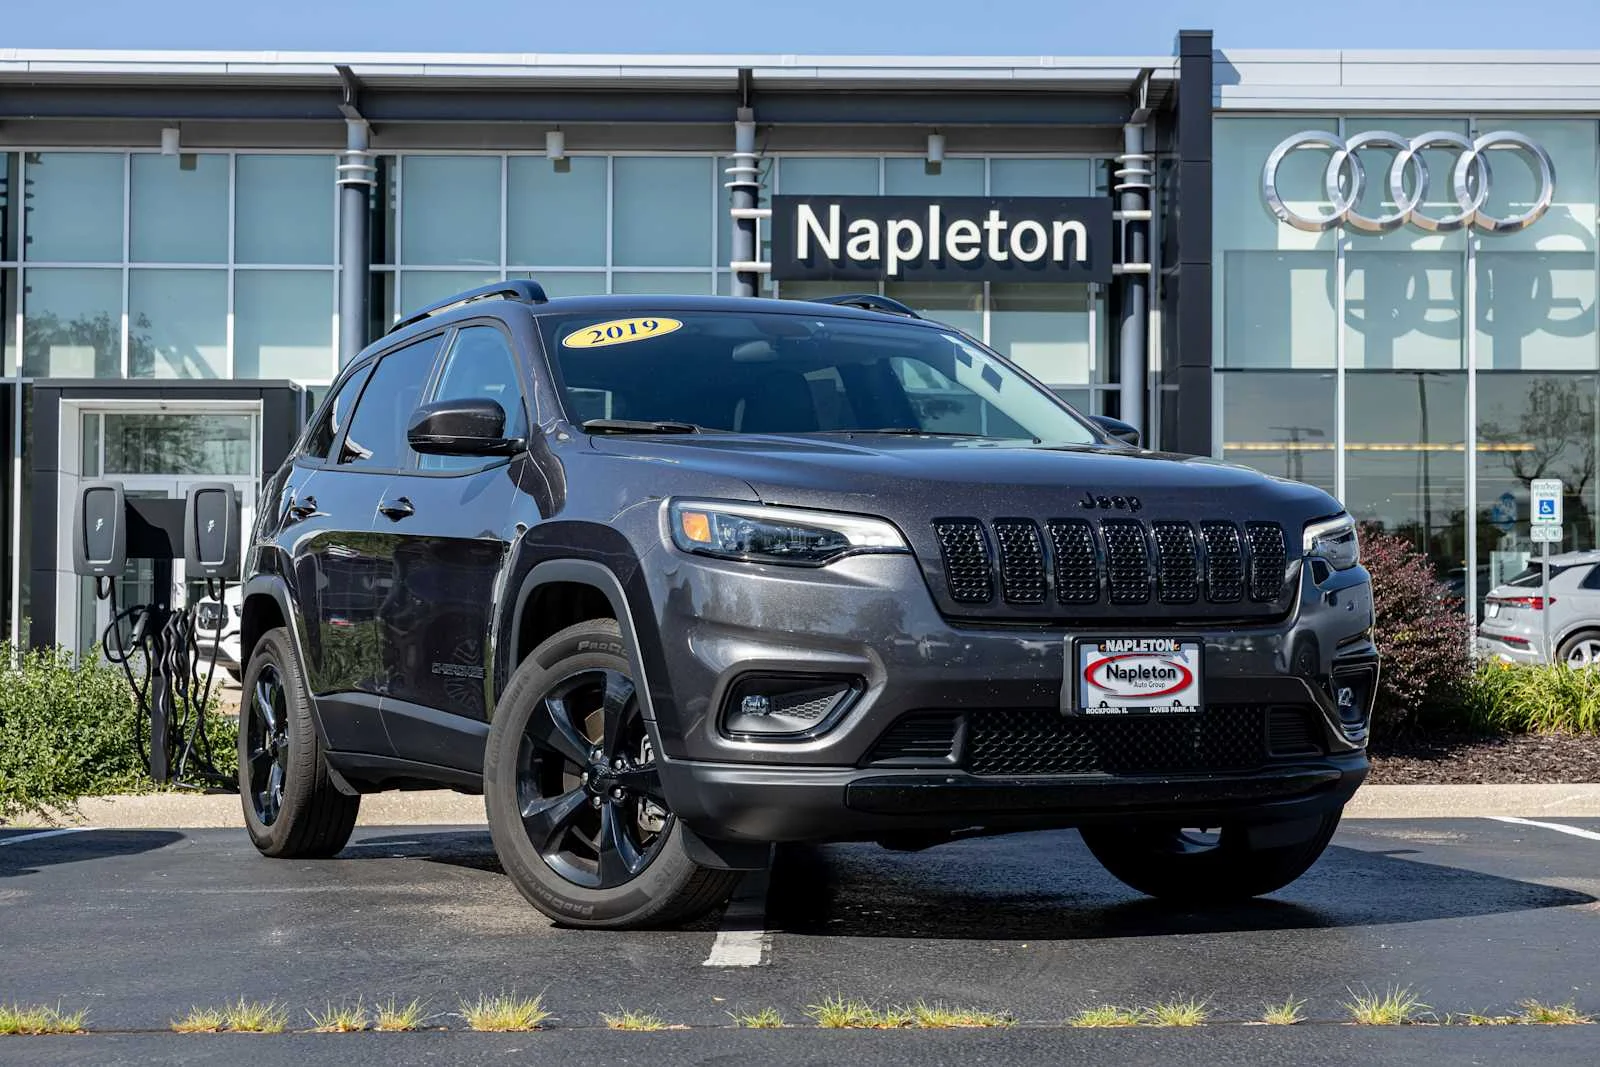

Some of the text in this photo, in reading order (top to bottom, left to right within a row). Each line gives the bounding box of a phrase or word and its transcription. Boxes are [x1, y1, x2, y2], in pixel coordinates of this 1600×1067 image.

[797, 204, 1087, 275] Napleton
[586, 319, 659, 344] 2019
[1079, 491, 1142, 512] Jeep
[1105, 639, 1175, 652] NAPLETON
[1106, 664, 1176, 682] Napleton
[1148, 681, 1166, 689] Group
